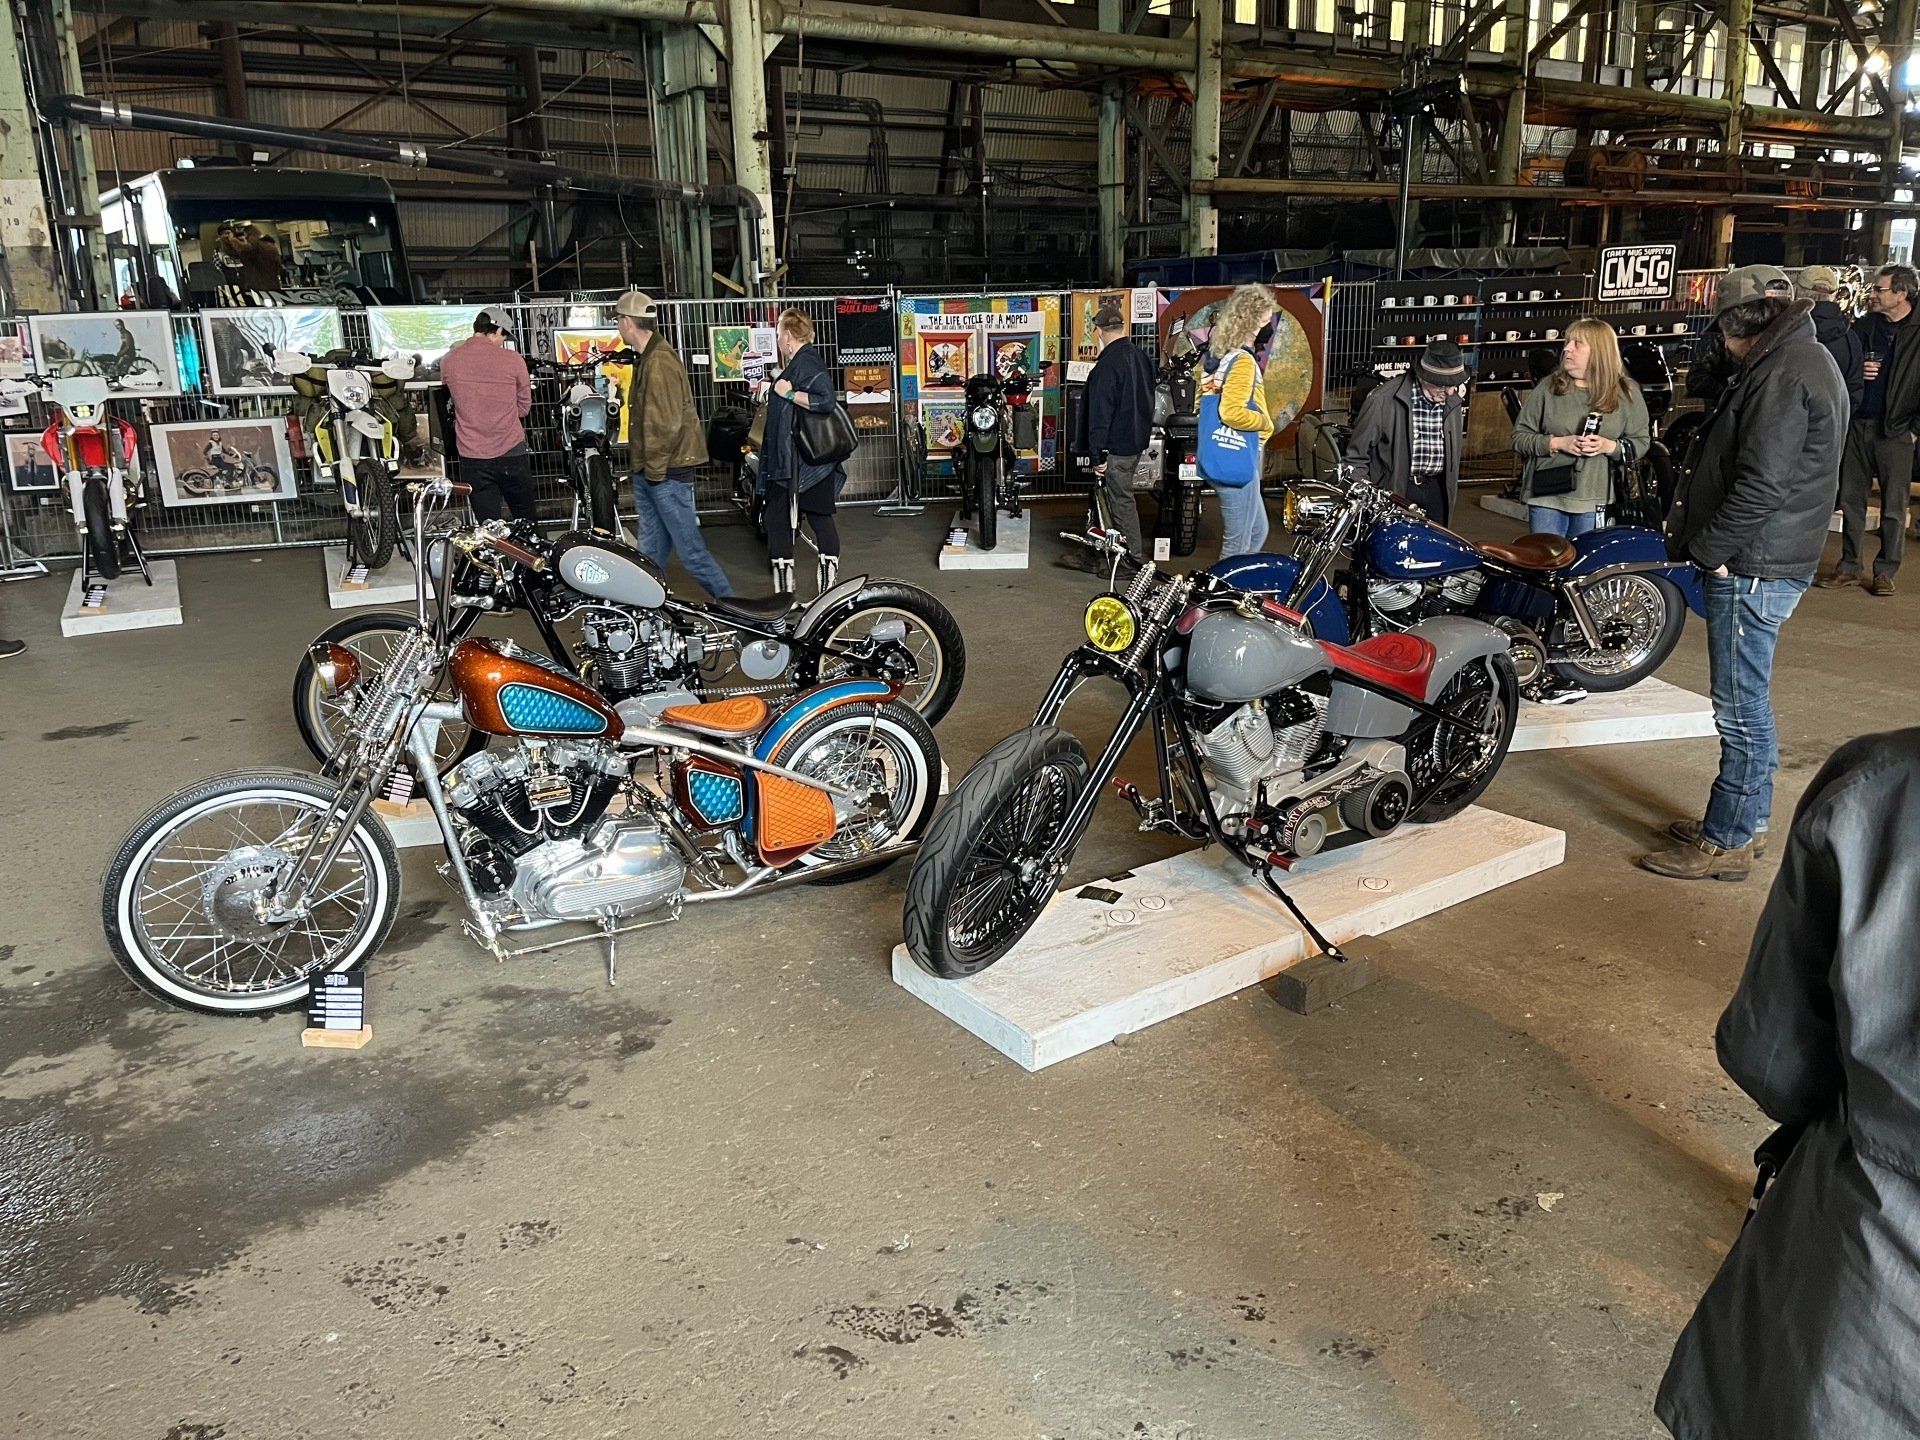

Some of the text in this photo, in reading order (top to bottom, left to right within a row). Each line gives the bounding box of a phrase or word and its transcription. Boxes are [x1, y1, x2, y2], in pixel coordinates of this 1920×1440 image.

[1607, 250, 1626, 258] CAMP
[1627, 248, 1643, 256] MUG
[1644, 248, 1665, 256] SUPPLY
[1602, 289, 1617, 297] HAND
[1618, 287, 1640, 297] PAINTED
[1643, 286, 1669, 296] PORTLAND
[838, 304, 861, 313] BULL
[928, 314, 1028, 325] THE LIFE CYCLE OF A MOPED
[1078, 345, 1098, 356] MOTO
[1374, 362, 1411, 371] MORE INFO
[744, 367, 762, 377] $500
[1211, 434, 1229, 443] PLAY
